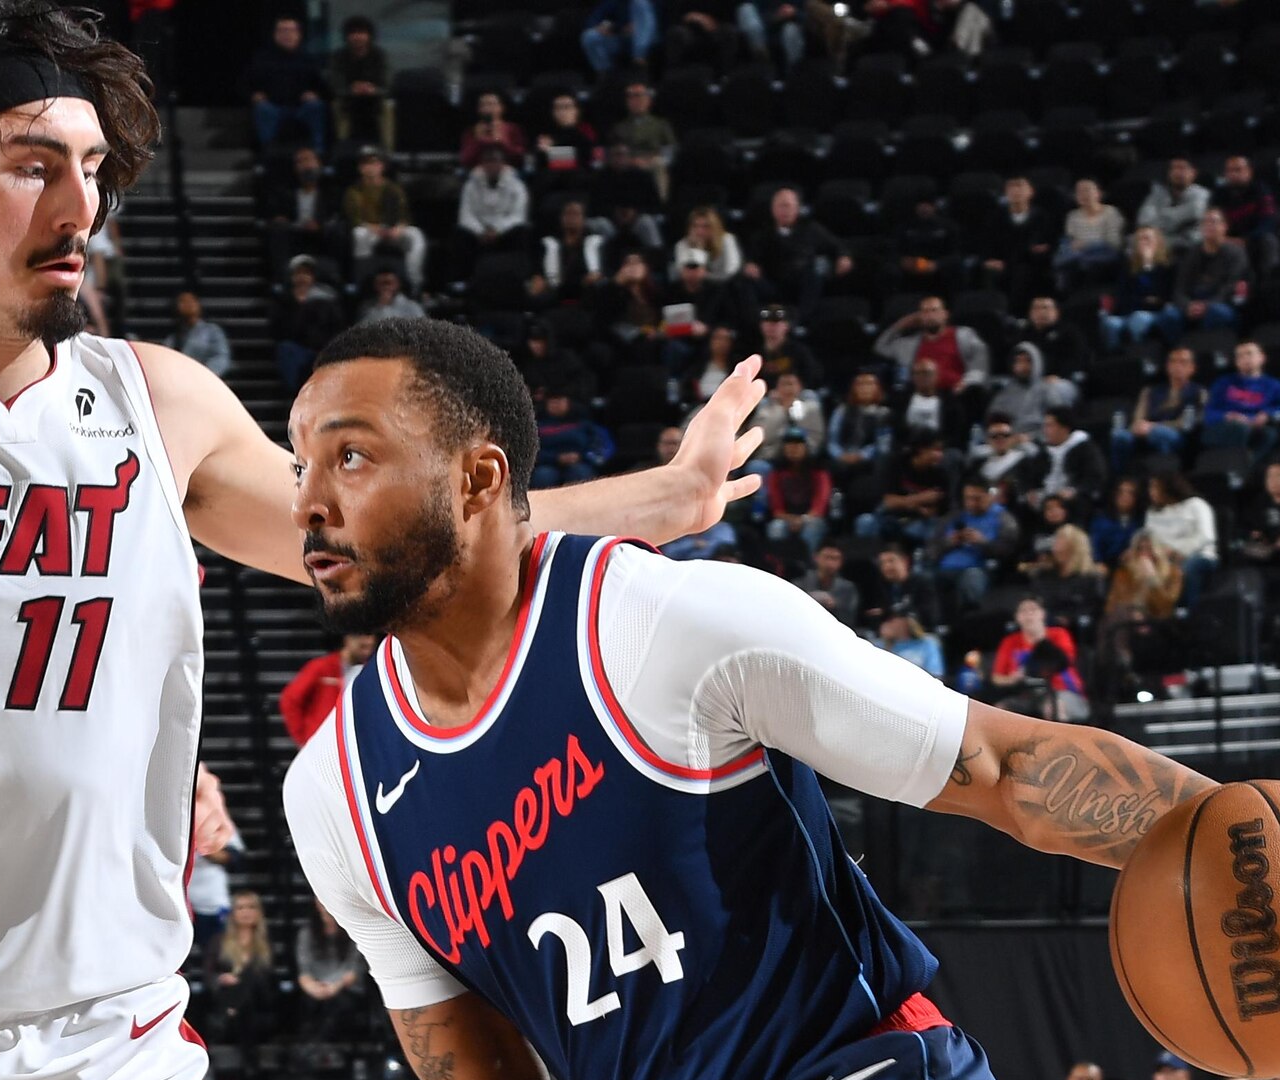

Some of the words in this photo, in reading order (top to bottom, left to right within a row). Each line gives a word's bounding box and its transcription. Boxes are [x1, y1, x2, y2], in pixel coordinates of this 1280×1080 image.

[4, 595, 113, 712] 11
[409, 734, 605, 965] Clippers
[528, 872, 686, 1026] 24
